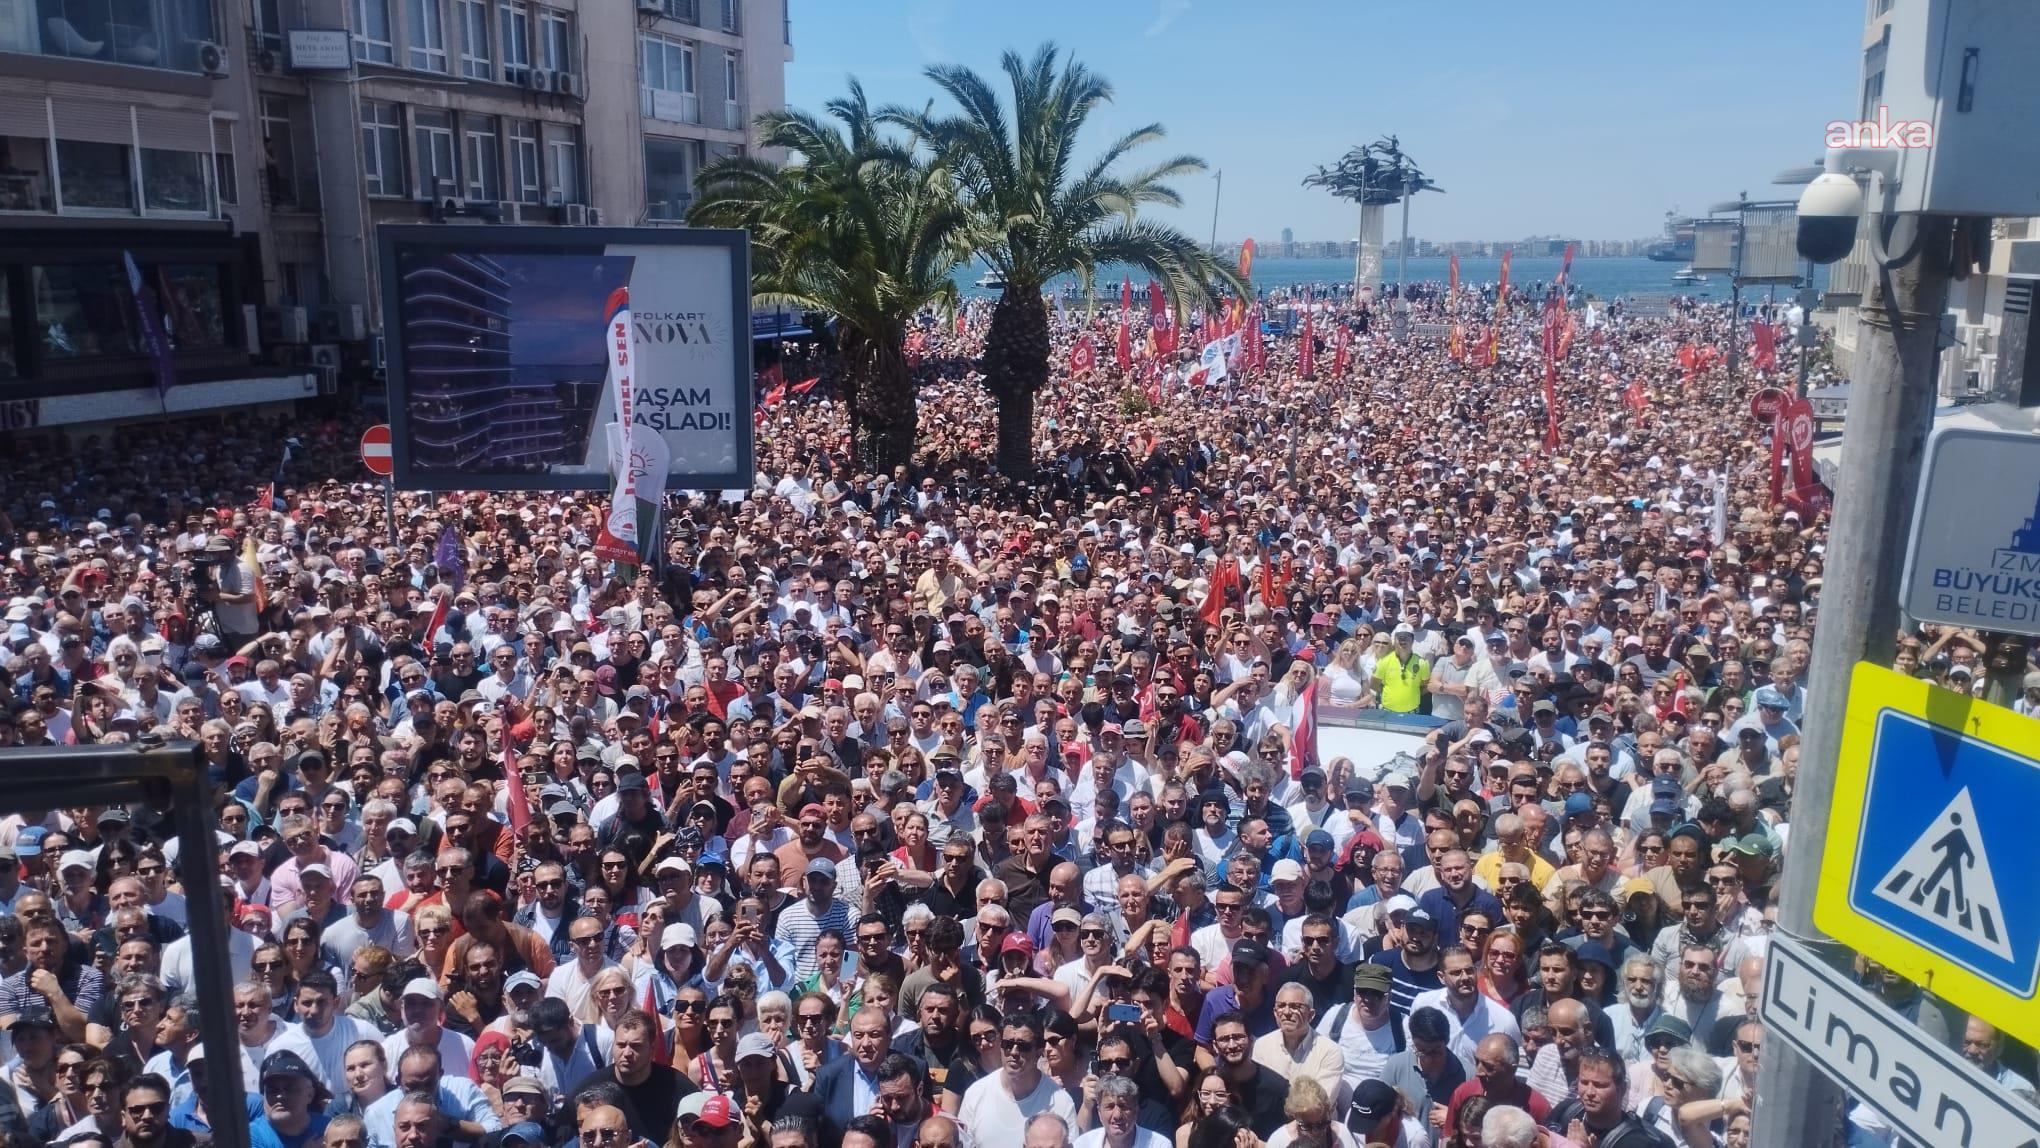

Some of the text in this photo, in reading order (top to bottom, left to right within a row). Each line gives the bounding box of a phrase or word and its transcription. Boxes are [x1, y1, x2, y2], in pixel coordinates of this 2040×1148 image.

[633, 312, 706, 321] FOLKART
[614, 323, 629, 367] SEN
[634, 323, 712, 345] NOVA
[634, 387, 711, 412] AŞAM
[614, 412, 731, 434] AŞLADI!
[1772, 959, 1973, 1148] Liman
